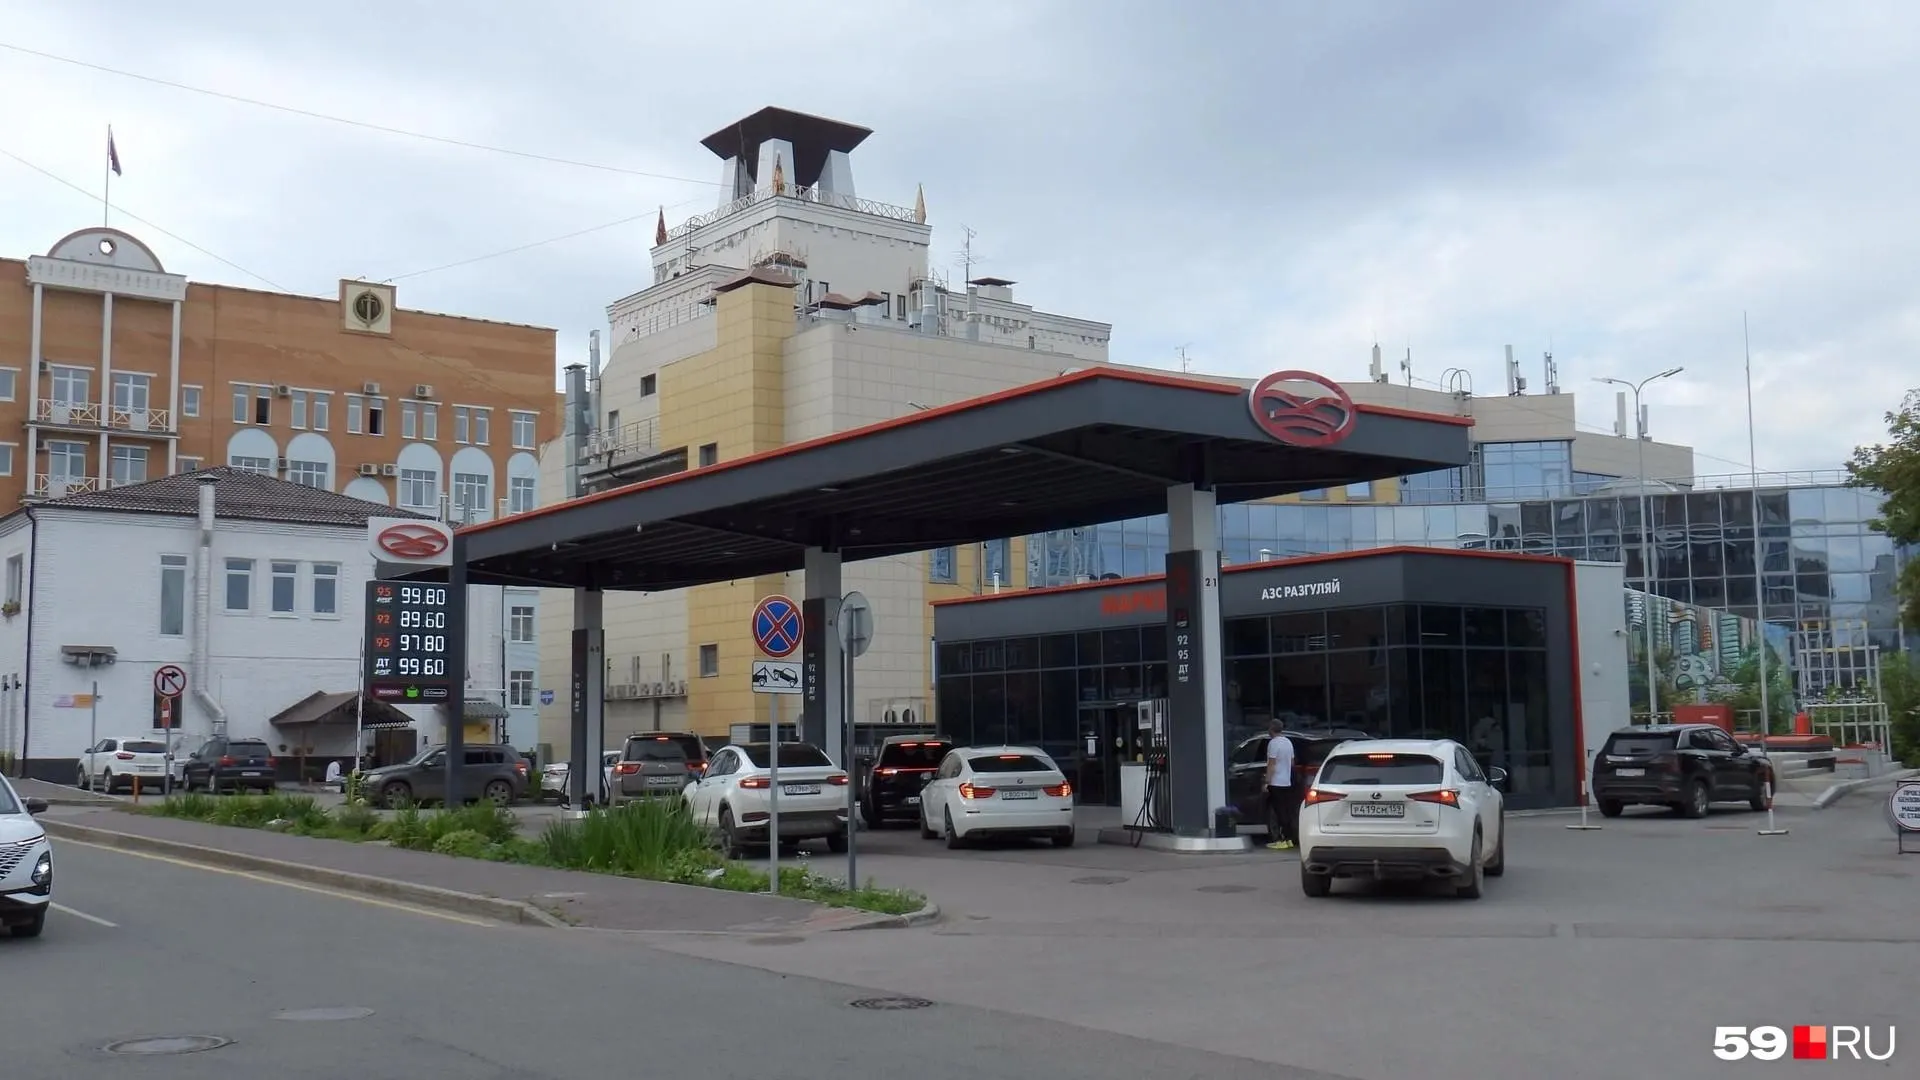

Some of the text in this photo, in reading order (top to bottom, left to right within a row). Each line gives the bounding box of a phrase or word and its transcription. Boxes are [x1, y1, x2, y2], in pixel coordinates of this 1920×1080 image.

[377, 586, 392, 597] 95
[401, 587, 445, 605] 99.80
[1261, 578, 1340, 600] АЗС РАЗГУЛЯЙ
[376, 610, 445, 629] 92 89.60
[375, 634, 445, 652] 95 97.80
[1177, 635, 1188, 646] 92
[1178, 649, 1189, 660] 95
[376, 658, 390, 669] ДТ
[399, 657, 444, 675] 99.60
[1178, 664, 1188, 675] ДТ
